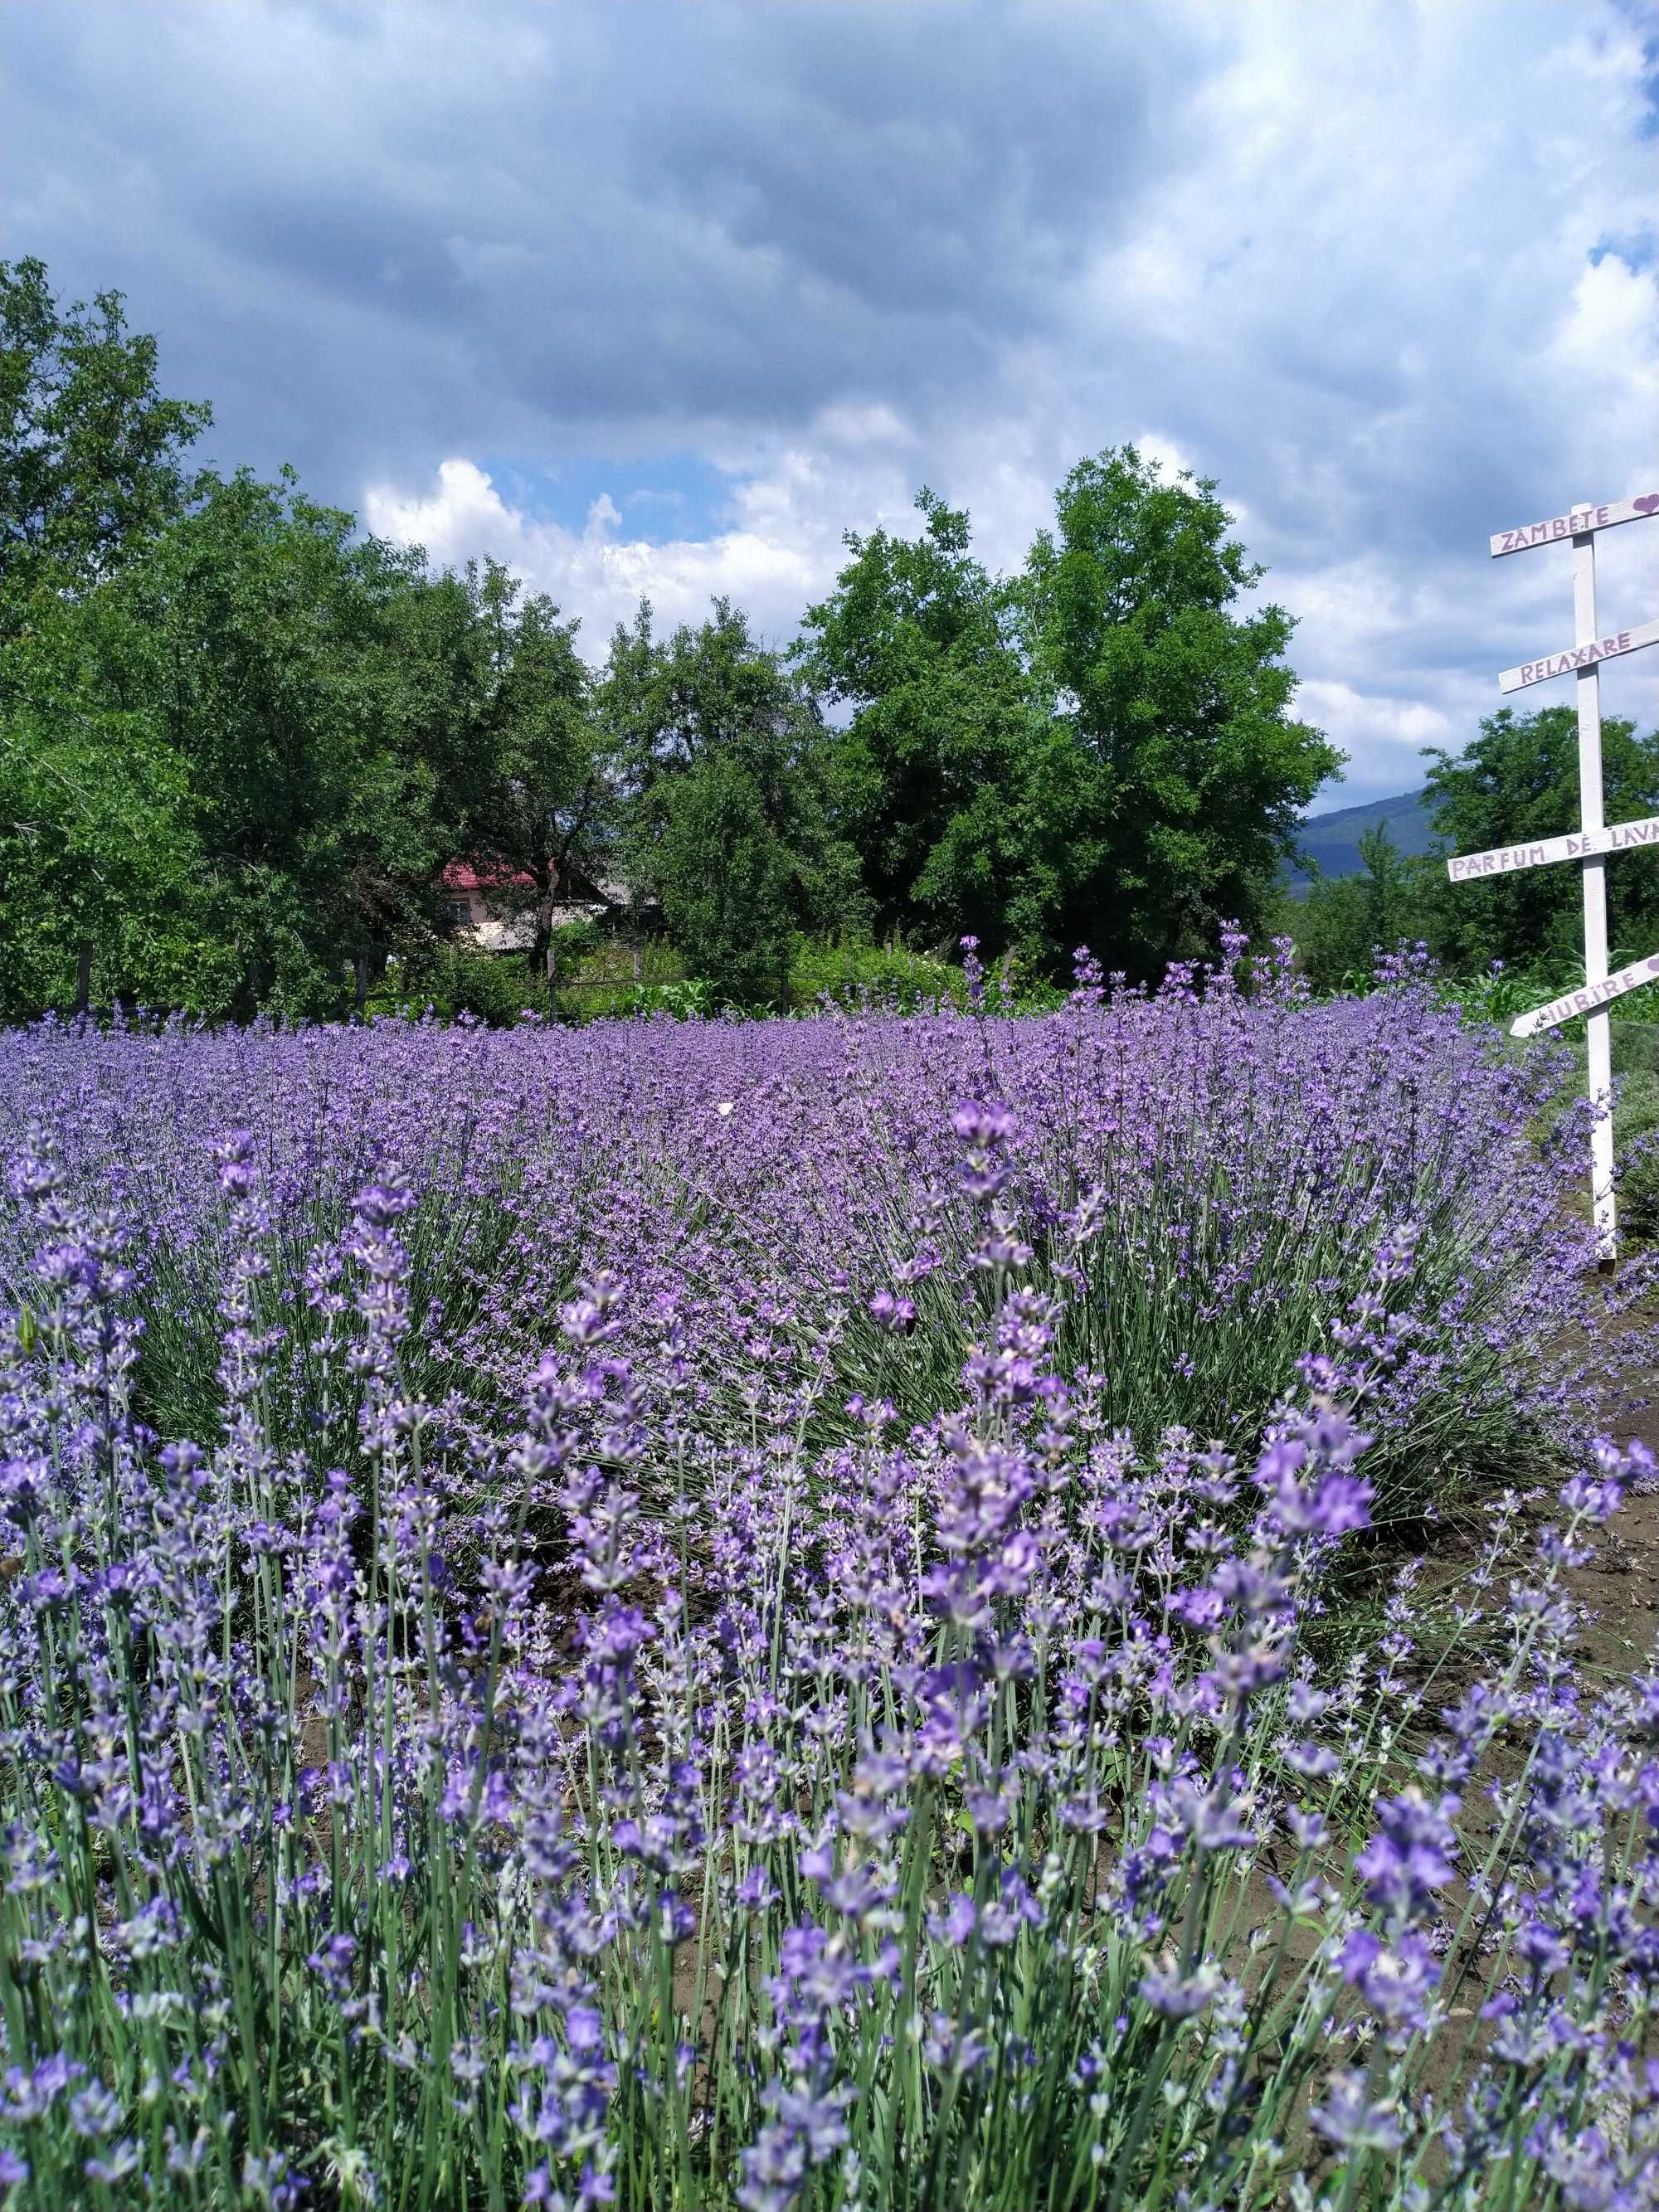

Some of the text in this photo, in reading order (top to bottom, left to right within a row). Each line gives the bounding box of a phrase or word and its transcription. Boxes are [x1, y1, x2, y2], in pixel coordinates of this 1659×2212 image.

[1501, 507, 1608, 552] ZAMBETE
[1521, 632, 1631, 683] RELAXARE
[1452, 845, 1545, 879] PARFUM
[1566, 837, 1592, 855] DE
